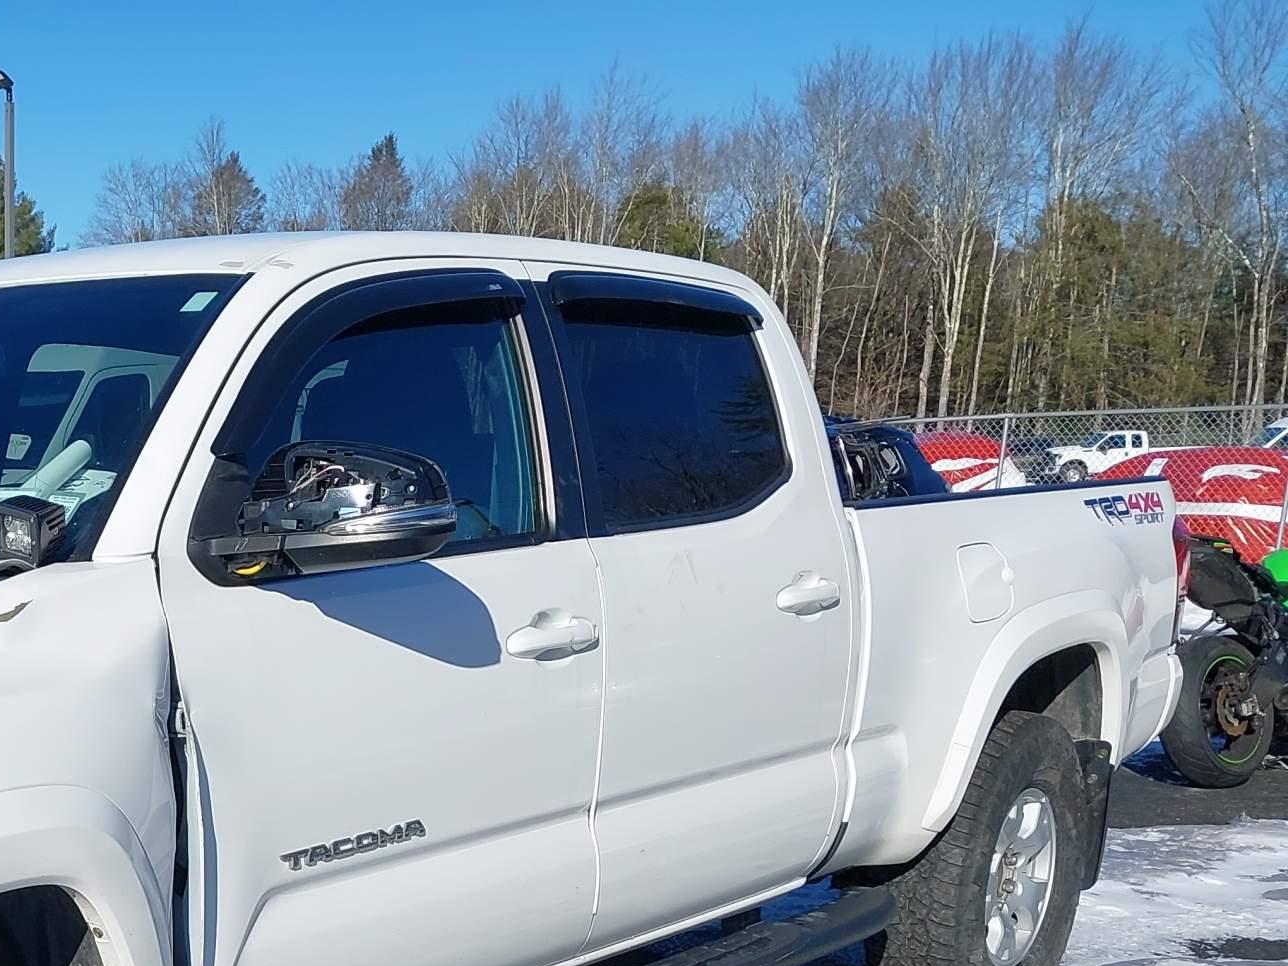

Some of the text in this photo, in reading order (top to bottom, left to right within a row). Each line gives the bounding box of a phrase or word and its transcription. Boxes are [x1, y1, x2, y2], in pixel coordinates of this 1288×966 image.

[1083, 495, 1133, 526] TRD
[1134, 512, 1164, 525] SPORT
[279, 818, 427, 871] TACOMA
